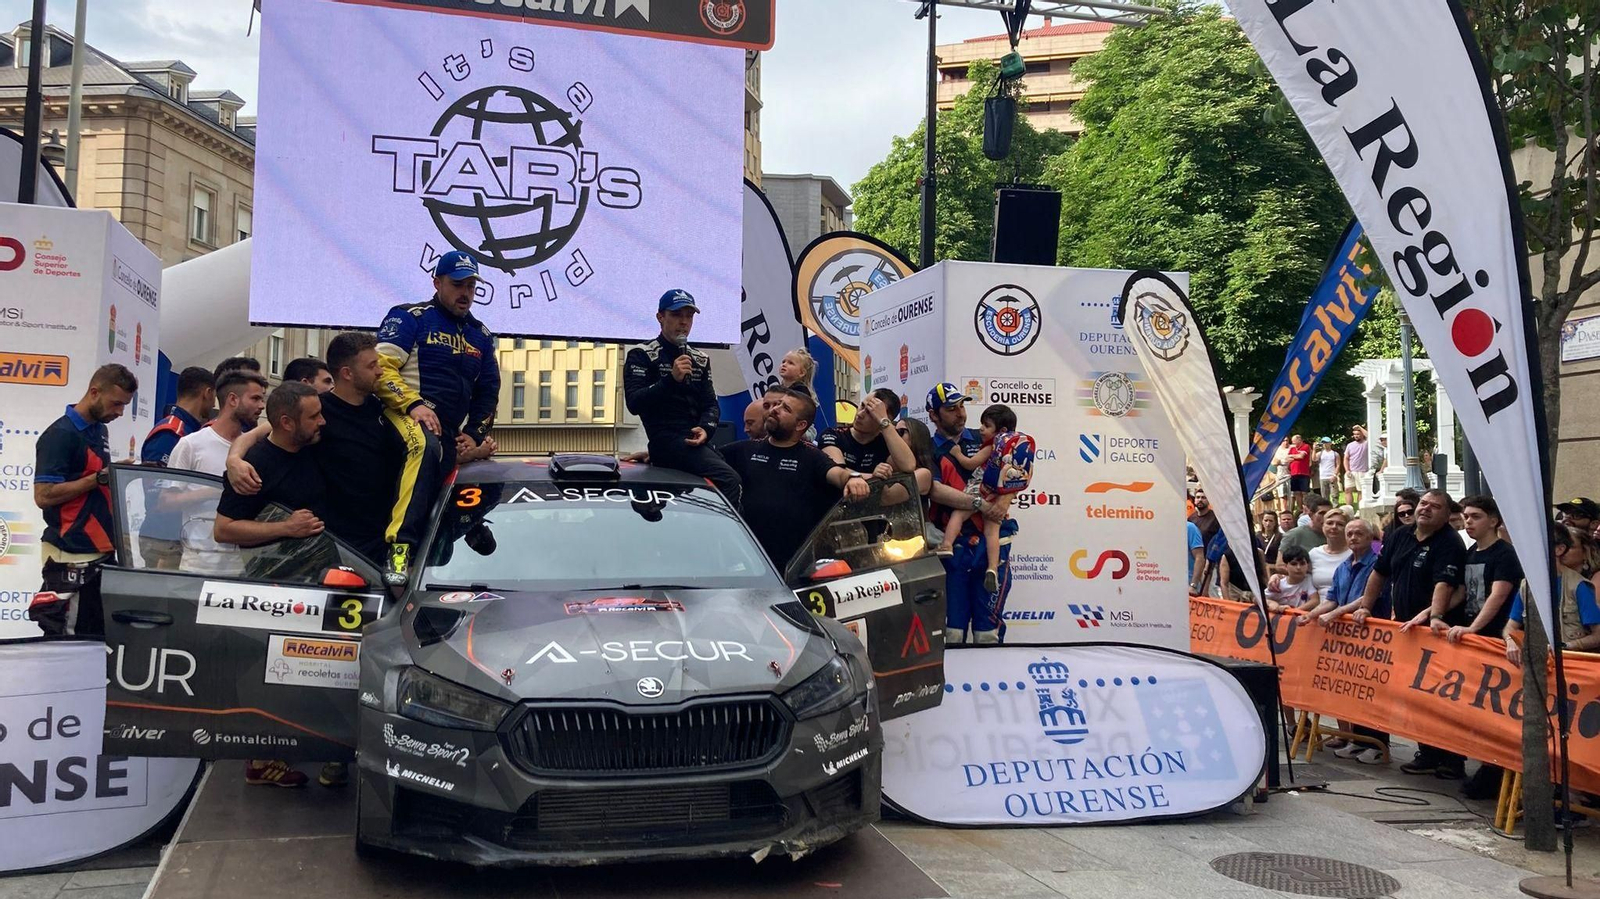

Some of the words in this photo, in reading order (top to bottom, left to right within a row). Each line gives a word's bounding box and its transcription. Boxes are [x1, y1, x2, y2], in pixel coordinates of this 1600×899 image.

[418, 38, 535, 101] It's
[371, 134, 643, 210] TAR's
[1264, 0, 1358, 108] La
[1342, 96, 1519, 425] Región
[34, 252, 67, 263] Consejo
[34, 260, 69, 270] Superior
[45, 268, 81, 278] Deportes
[137, 279, 157, 308] OURENSE
[870, 315, 891, 332] Concello
[891, 312, 898, 324] de
[897, 295, 933, 323] OURENSE
[21, 321, 44, 329] Sport
[45, 322, 78, 331] Institute
[985, 310, 1010, 345] ESCUDERÍA
[1011, 313, 1031, 344] OURENSE
[990, 379, 1030, 391] Concello
[1032, 380, 1043, 391] de
[990, 392, 1053, 405] OURENSE
[1109, 437, 1159, 449] DEPORTE
[1109, 451, 1155, 464] GALEGO
[456, 487, 483, 508] 3
[1085, 504, 1155, 520] telemiño
[1017, 553, 1054, 562] Federación
[1039, 563, 1048, 571] de
[809, 591, 828, 617] 3
[834, 590, 855, 605] La
[854, 580, 900, 600] Región
[203, 592, 235, 609] La
[241, 594, 320, 618] Región
[338, 598, 364, 630] 3
[1110, 610, 1134, 622] MSi
[1188, 600, 1226, 621] PORTE
[1235, 604, 1298, 655] OU
[1324, 622, 1370, 641] MUSEO
[1371, 627, 1394, 645] DO
[297, 643, 343, 657] Recalvi
[525, 640, 754, 664] A-SECUR
[1320, 638, 1395, 666] AUTOMÓBIL
[106, 645, 198, 696] UR
[297, 668, 341, 679] recoletas
[1316, 655, 1390, 685] ESTANISLAO
[1408, 647, 1466, 702] La
[1312, 673, 1376, 702] REVERTER
[27, 706, 82, 741] de
[215, 733, 298, 747] Fontalclima
[427, 743, 460, 761] Sport
[456, 747, 470, 768] 2
[836, 747, 869, 769] MICHELIN
[962, 746, 1188, 788] DEPUTACIÓN
[401, 769, 455, 791] MICHELIN
[1004, 784, 1170, 818] OURENSE
